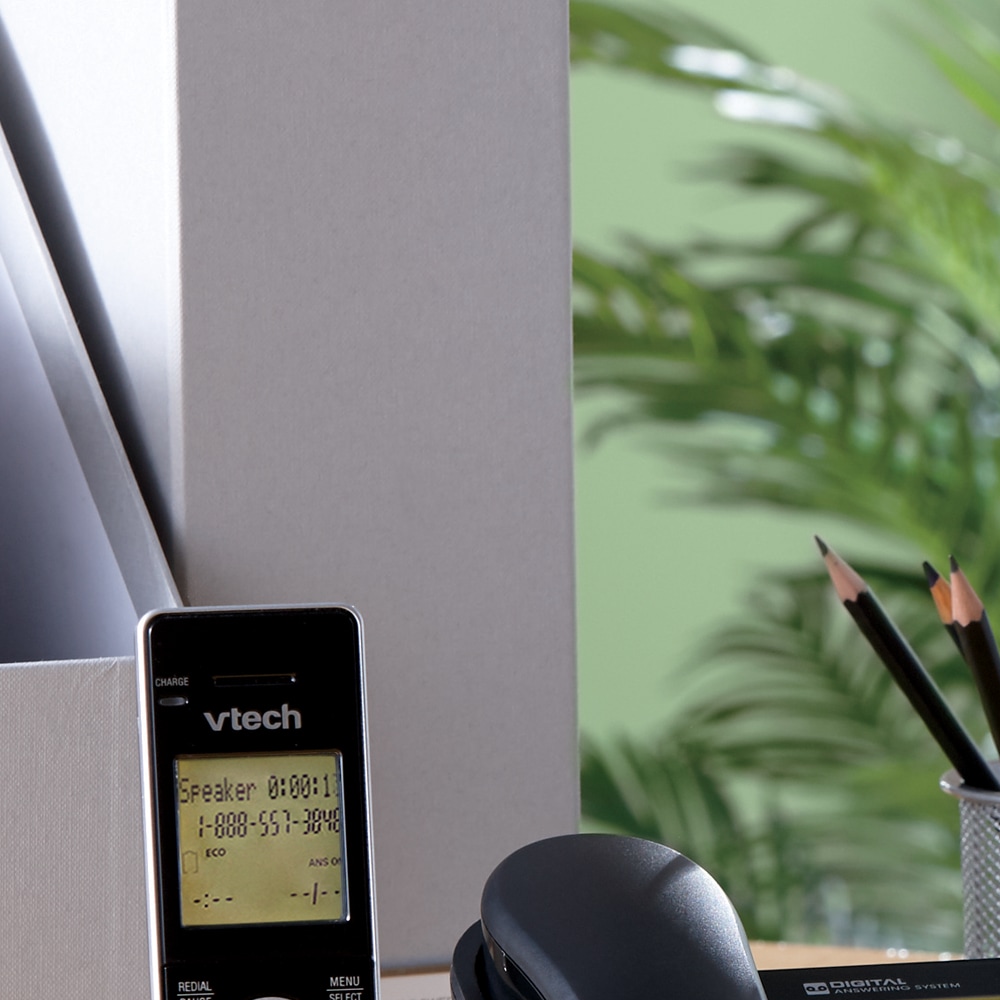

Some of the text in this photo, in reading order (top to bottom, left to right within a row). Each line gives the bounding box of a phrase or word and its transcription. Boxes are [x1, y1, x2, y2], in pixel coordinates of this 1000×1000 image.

[155, 677, 189, 687] CHARGE
[203, 704, 302, 731] vtech
[179, 773, 339, 803] Speaker 0:00:1
[205, 848, 226, 858] ECO
[308, 857, 329, 867] ANS
[178, 981, 212, 992] REDIAL
[329, 976, 360, 988] MENU
[829, 978, 907, 988] DIGITAL
[834, 982, 961, 994] ANSWERING SYSTEM
